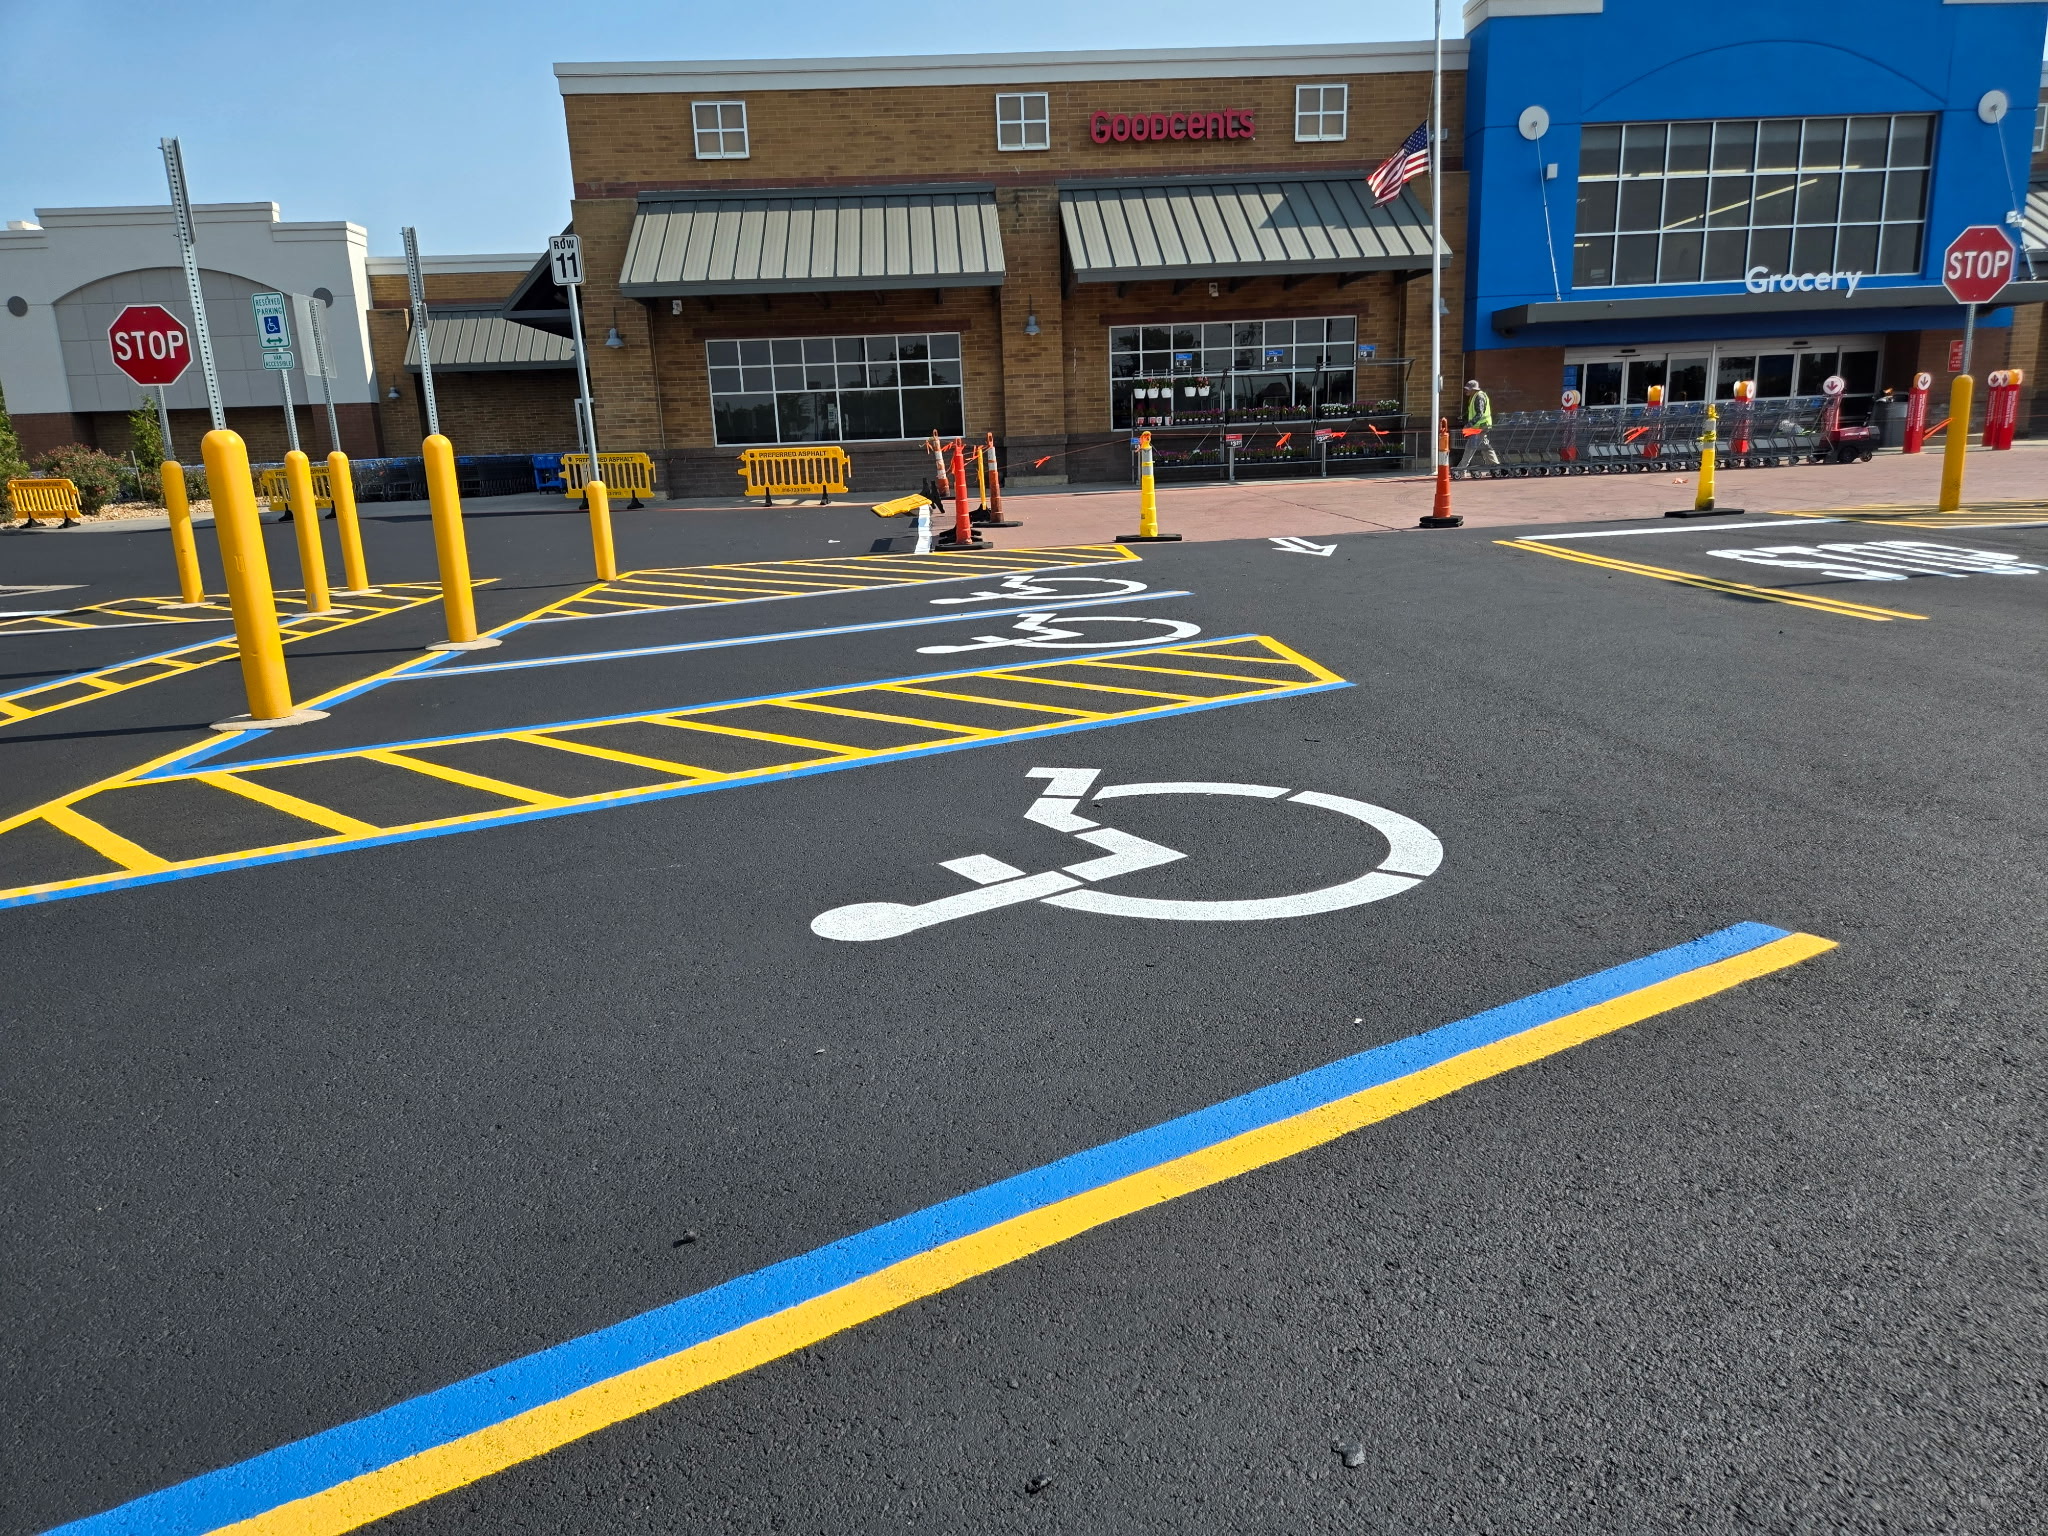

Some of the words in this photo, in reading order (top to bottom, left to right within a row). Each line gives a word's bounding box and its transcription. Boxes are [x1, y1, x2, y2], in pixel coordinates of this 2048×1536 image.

[553, 239, 574, 250] ROW
[556, 252, 578, 279] 11
[1948, 250, 2010, 280] STOP
[1745, 265, 1863, 299] Grocery
[255, 298, 281, 306] RESERVED
[257, 307, 283, 315] PARKING
[115, 330, 184, 361] STOP
[1706, 541, 2048, 582] STOP
